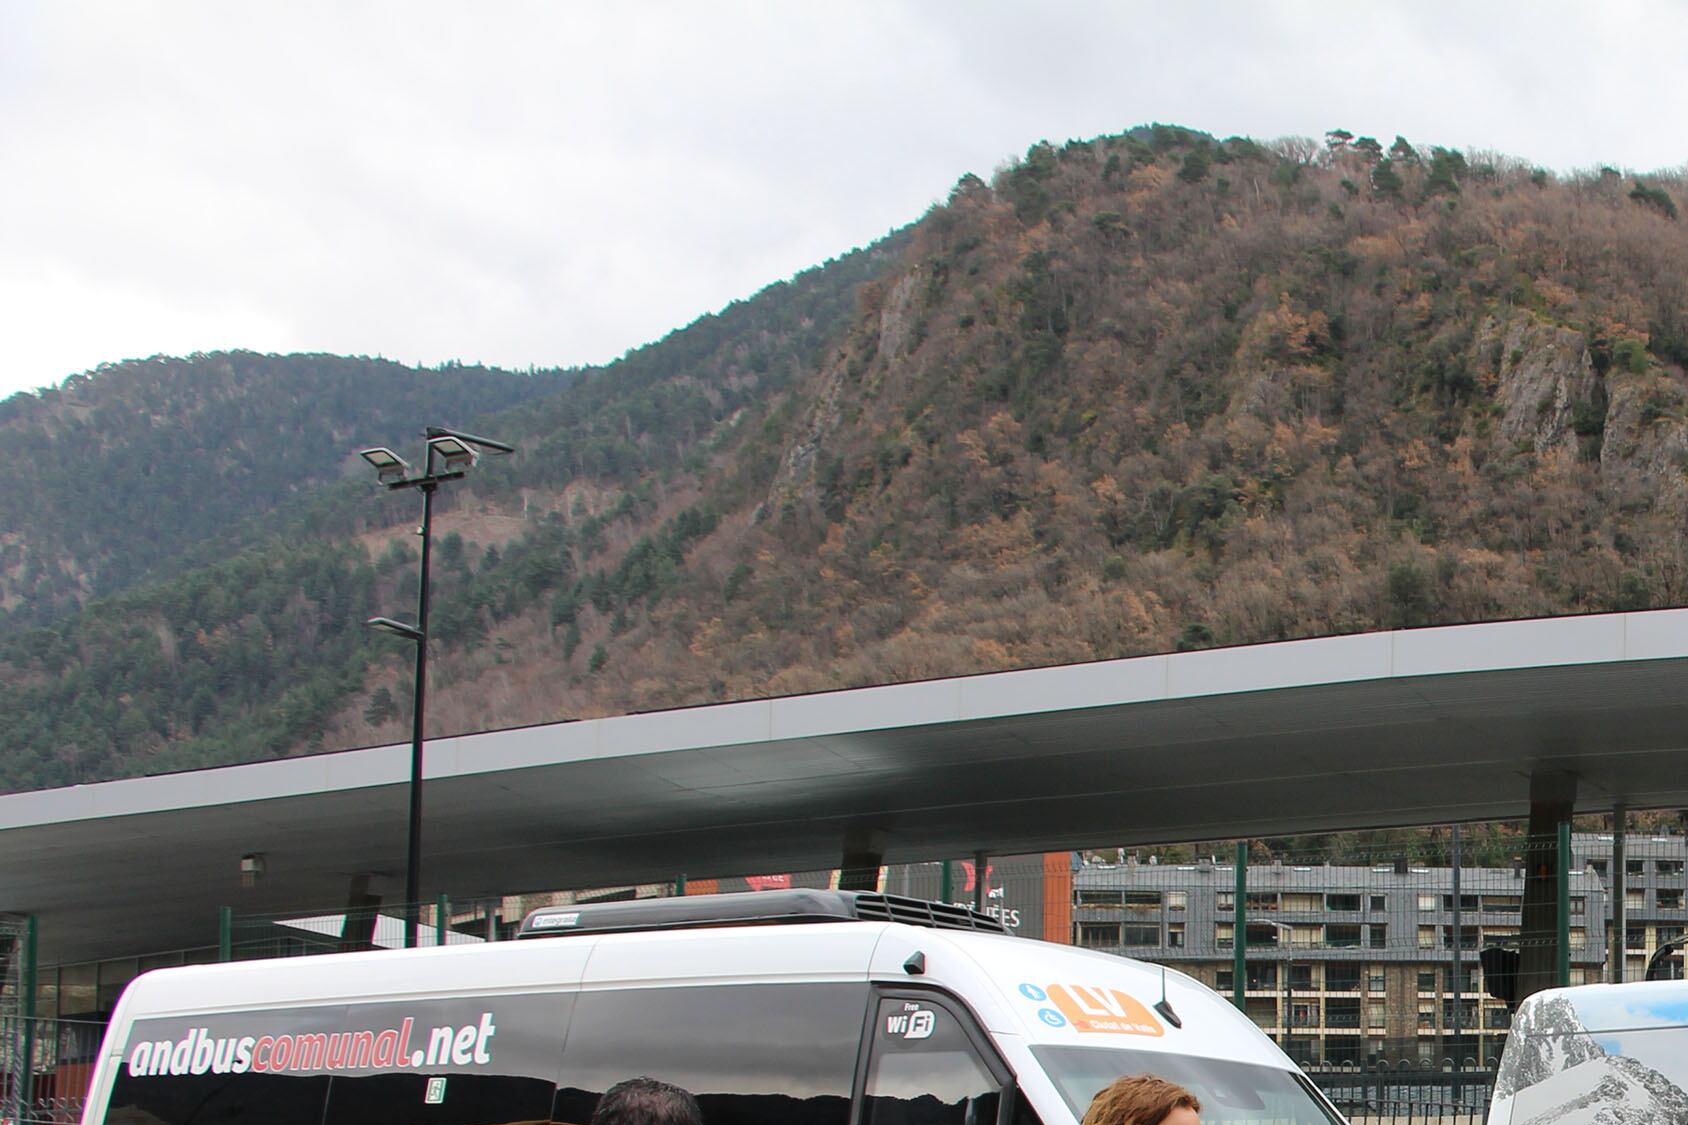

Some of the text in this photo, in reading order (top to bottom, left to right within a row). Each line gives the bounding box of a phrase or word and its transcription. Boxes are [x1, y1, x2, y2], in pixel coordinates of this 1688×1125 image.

[904, 1002, 919, 1011] Free
[1065, 984, 1127, 1018] LV
[129, 1012, 496, 1077] andbuscomunal.net
